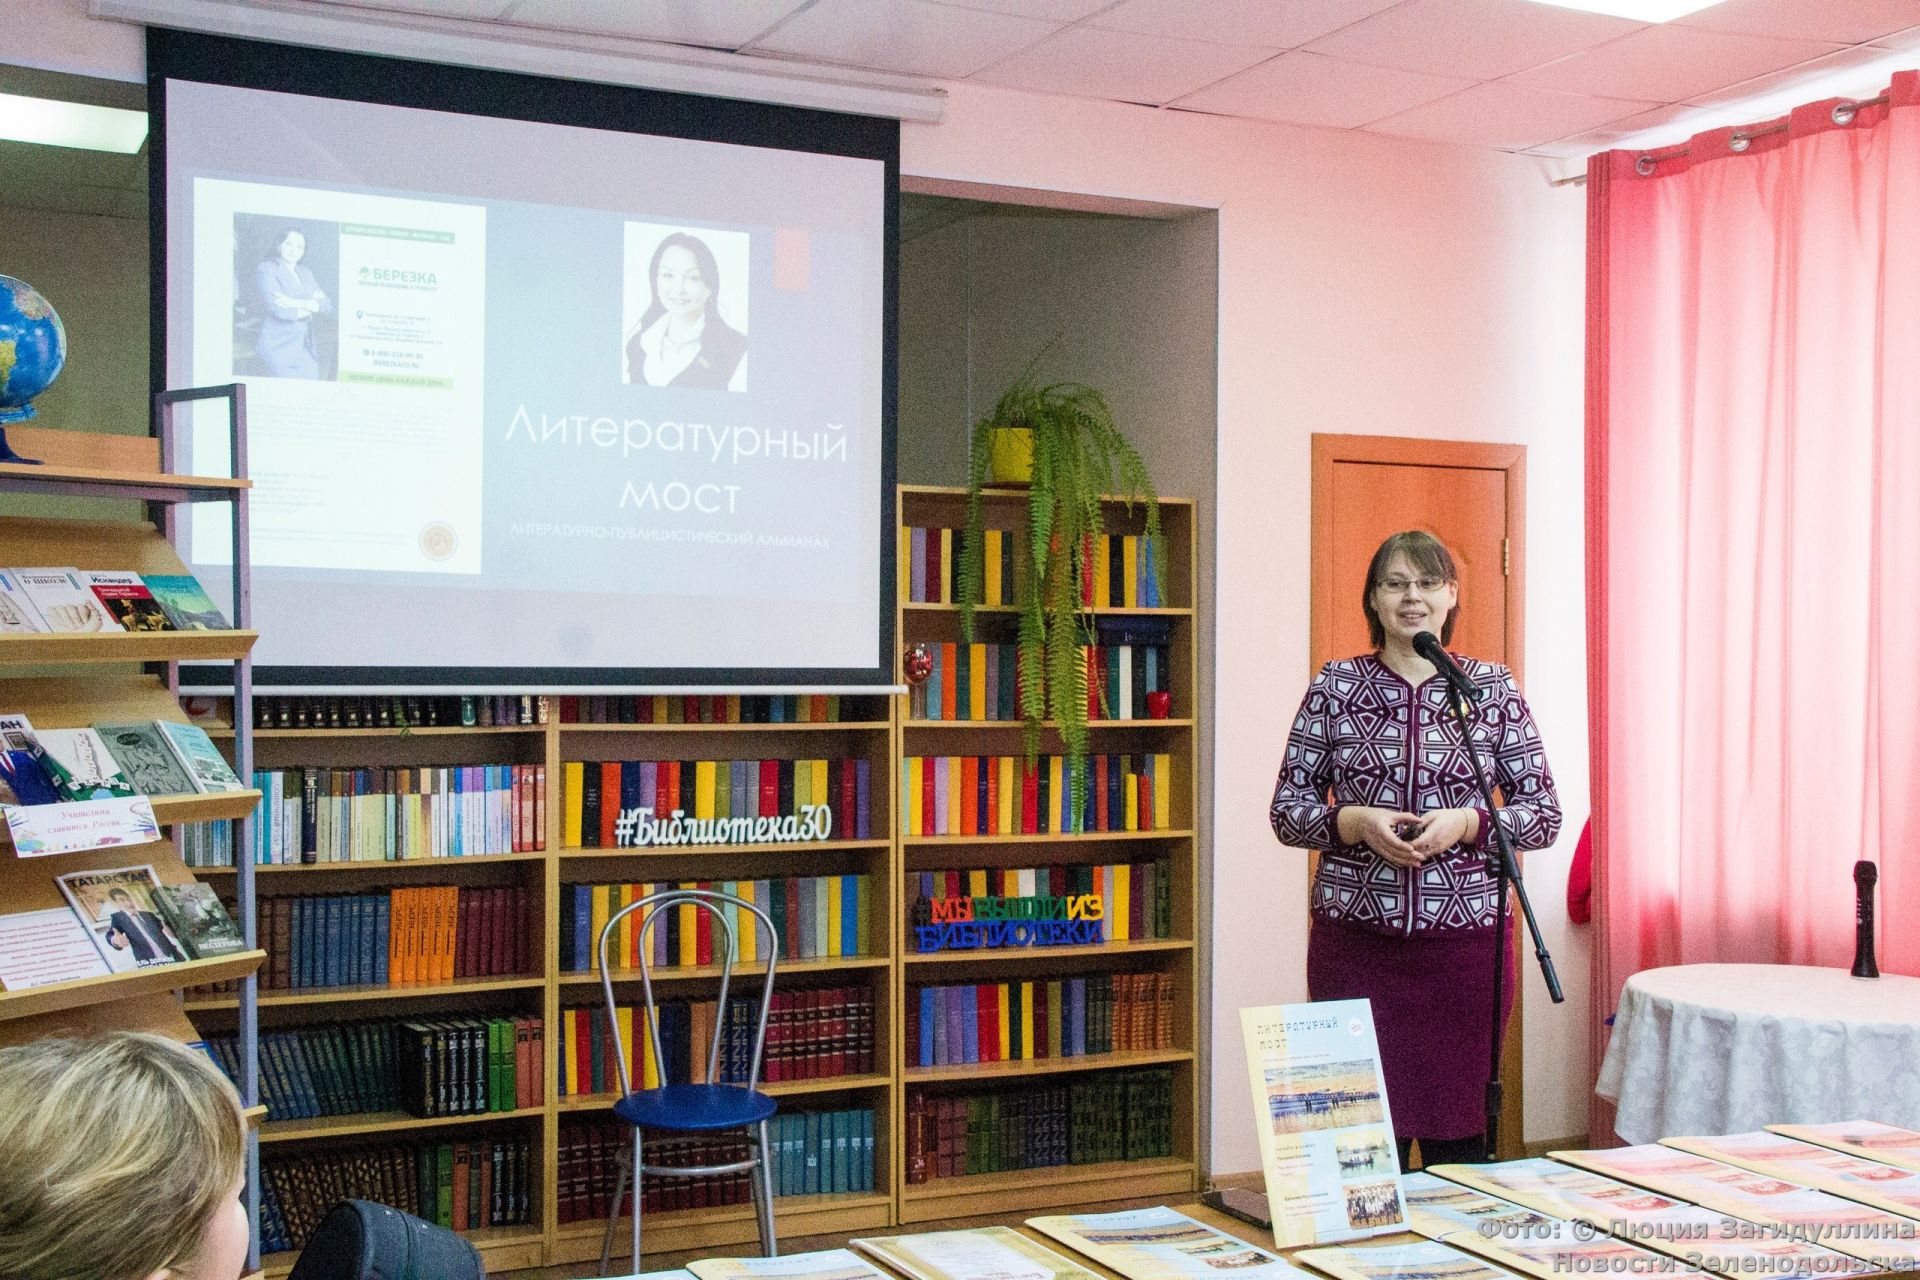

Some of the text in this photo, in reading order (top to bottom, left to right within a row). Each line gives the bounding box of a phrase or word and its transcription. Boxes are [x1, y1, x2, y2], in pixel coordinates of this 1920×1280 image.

[373, 268, 437, 284] БЕРЕЗКА
[505, 404, 847, 463] Литературный
[510, 523, 830, 550] ЛИТЕРАТУРНО-ПУБЛИЦИСТИЧЕСКИЙ АЛЬМАНАХ
[615, 805, 832, 846] #Библиотека30
[915, 918, 1105, 952] БИБЛИОТЕКИ
